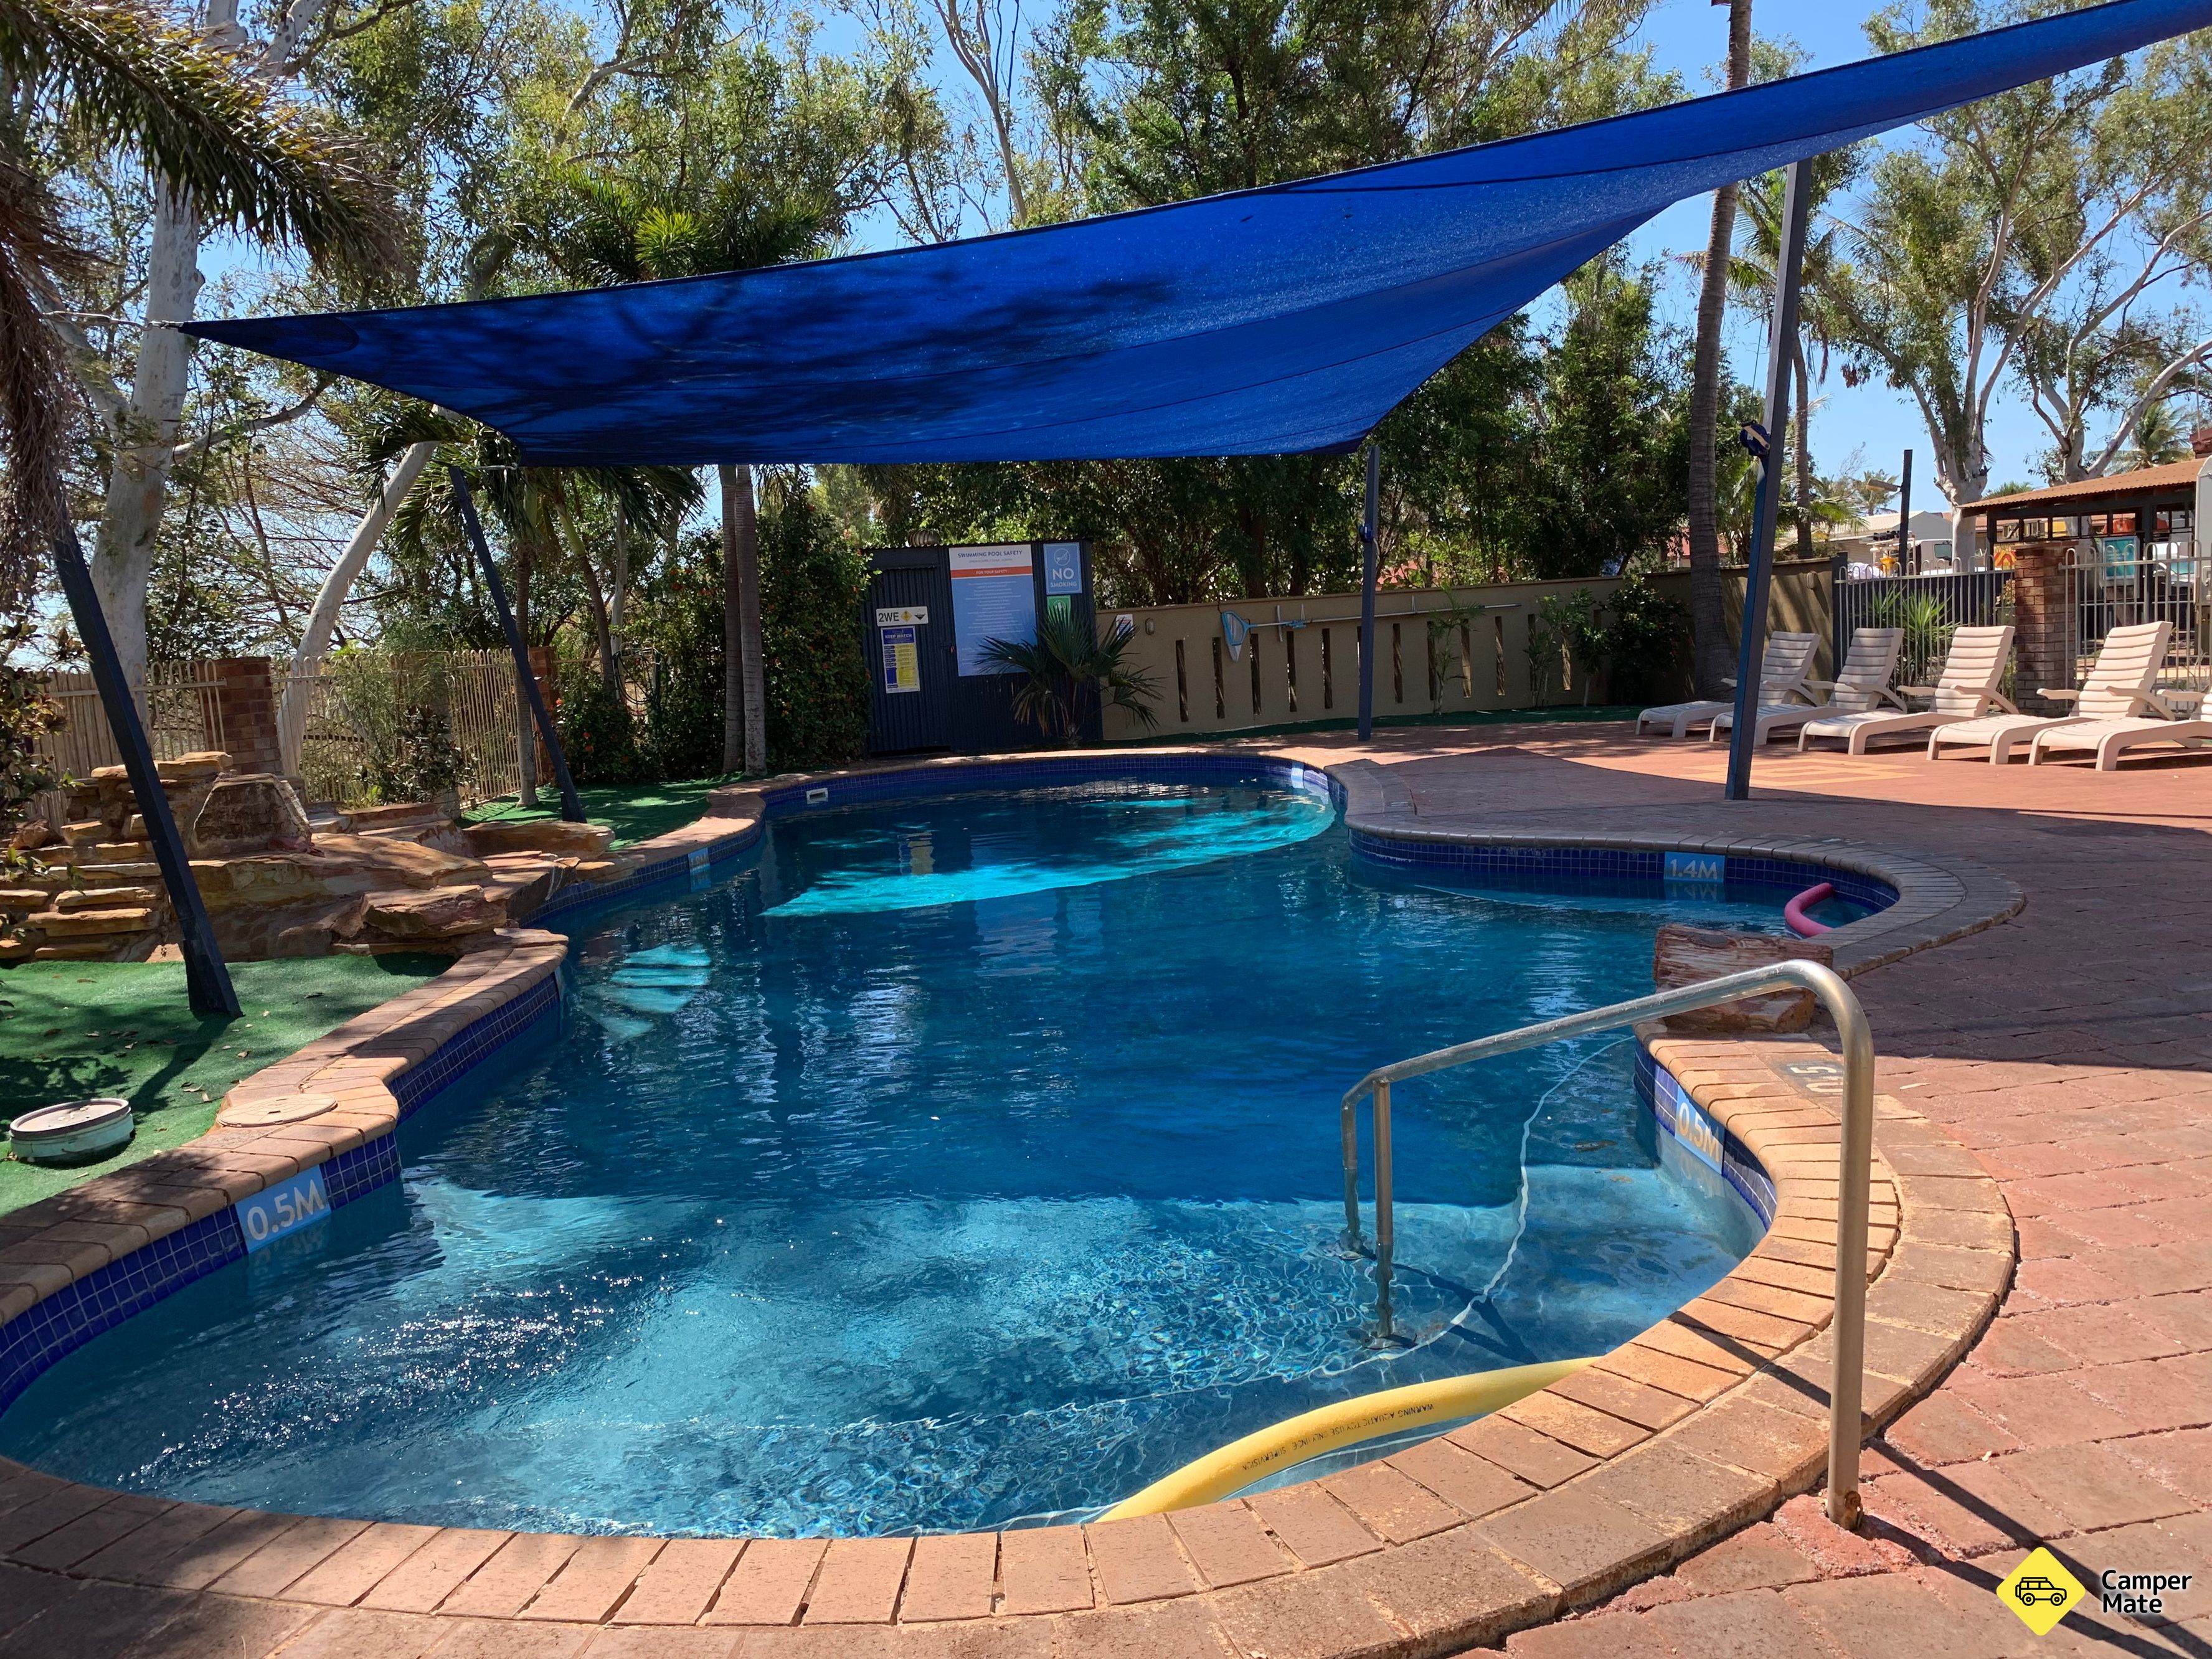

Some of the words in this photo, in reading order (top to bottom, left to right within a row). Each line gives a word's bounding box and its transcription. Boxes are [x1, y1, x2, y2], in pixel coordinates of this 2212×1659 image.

[1052, 567, 1074, 580] NO
[878, 612, 899, 623] 2WE
[1670, 859, 1718, 880] 1.4M
[1679, 1102, 1720, 1162] 0.5M
[247, 1179, 324, 1241] 0.5M
[1397, 1404, 1434, 1418] WARNING
[1363, 1412, 1394, 1427] AQUATIC
[1312, 1431, 1328, 1442] NLY
